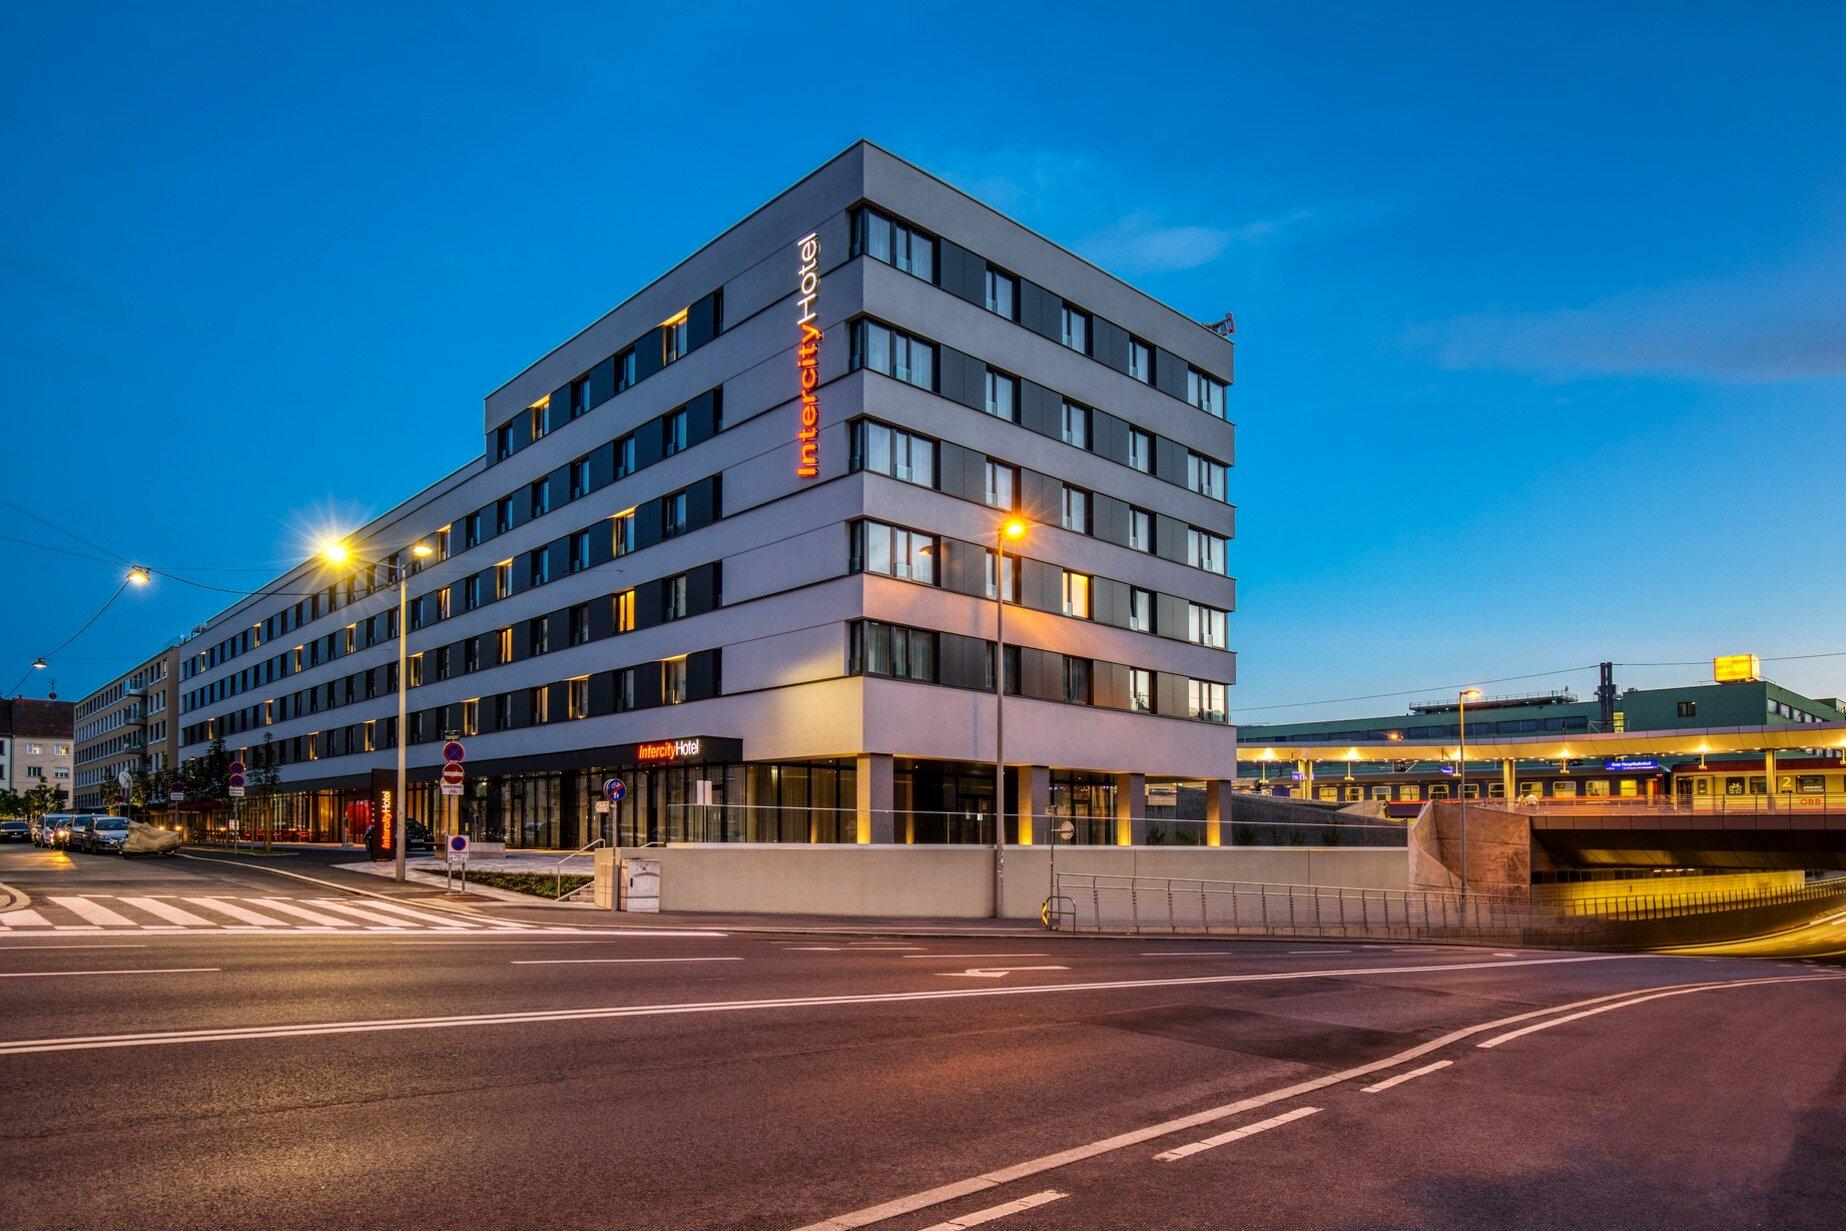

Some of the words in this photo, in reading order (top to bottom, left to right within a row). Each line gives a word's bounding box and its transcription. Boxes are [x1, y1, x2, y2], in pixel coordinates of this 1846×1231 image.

[797, 232, 823, 478] IntercityHotel
[639, 739, 699, 760] IntercityHotel
[1782, 776, 1792, 787] 2
[382, 791, 392, 849] IntercityHotel
